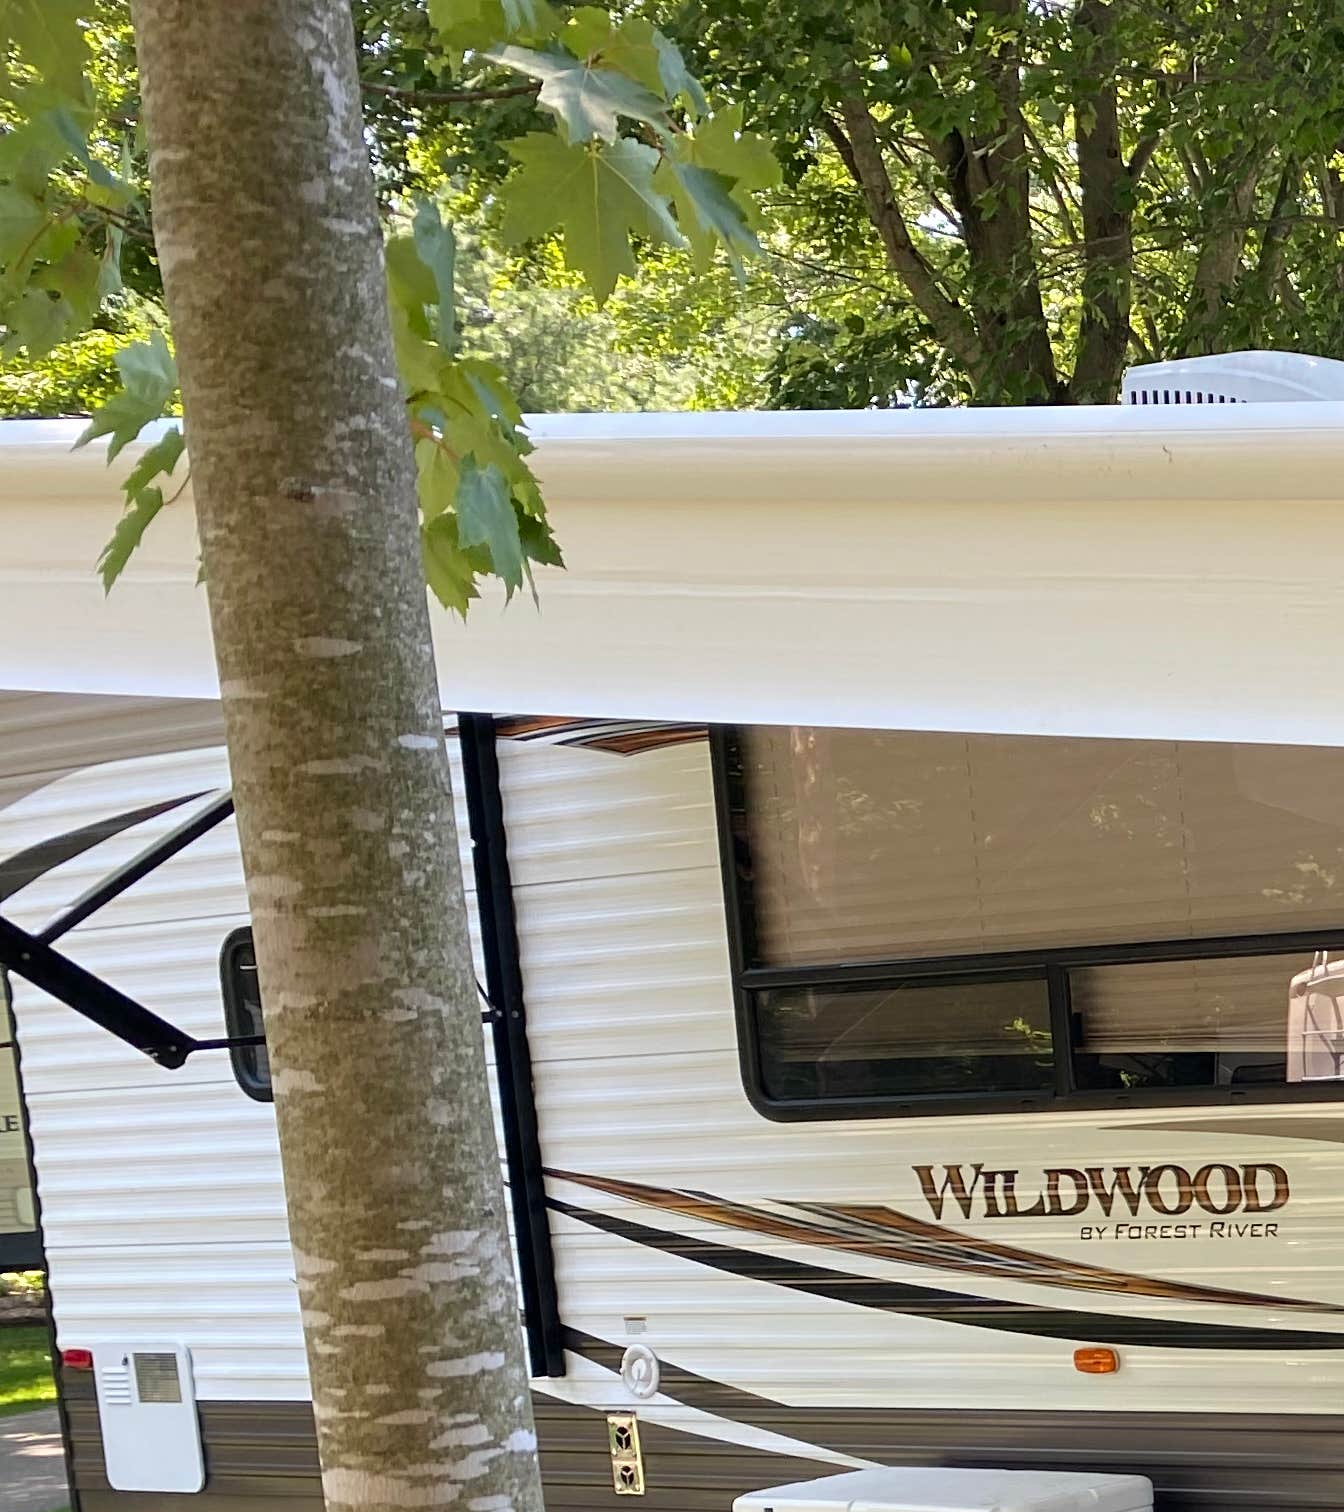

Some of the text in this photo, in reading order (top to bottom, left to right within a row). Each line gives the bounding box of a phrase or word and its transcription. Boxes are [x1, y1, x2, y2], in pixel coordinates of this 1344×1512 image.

[911, 1162, 1291, 1221] WILDWOOD
[1080, 1221, 1279, 1240] BY FOREST RIVER
